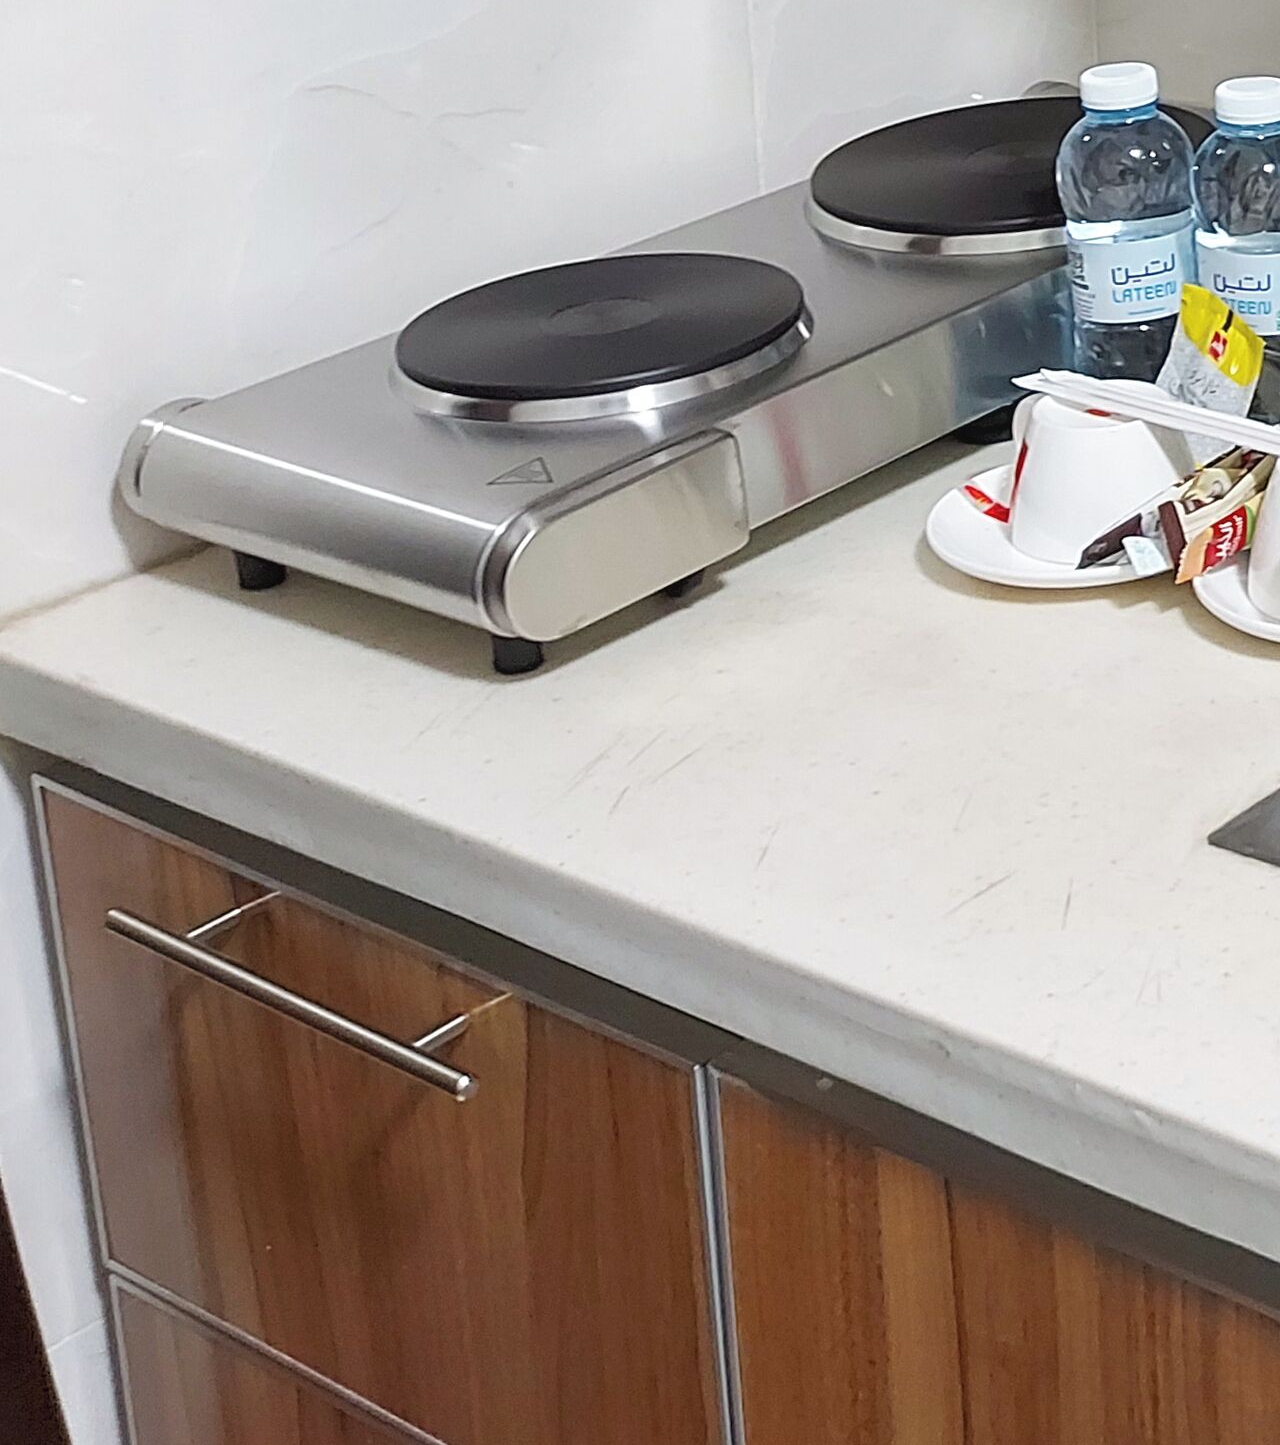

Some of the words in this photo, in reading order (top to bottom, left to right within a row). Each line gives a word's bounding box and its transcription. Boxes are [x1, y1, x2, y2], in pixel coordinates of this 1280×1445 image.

[1111, 253, 1176, 286] لتين
[1112, 280, 1177, 304] LATEEN
[1213, 273, 1271, 295] لتين
